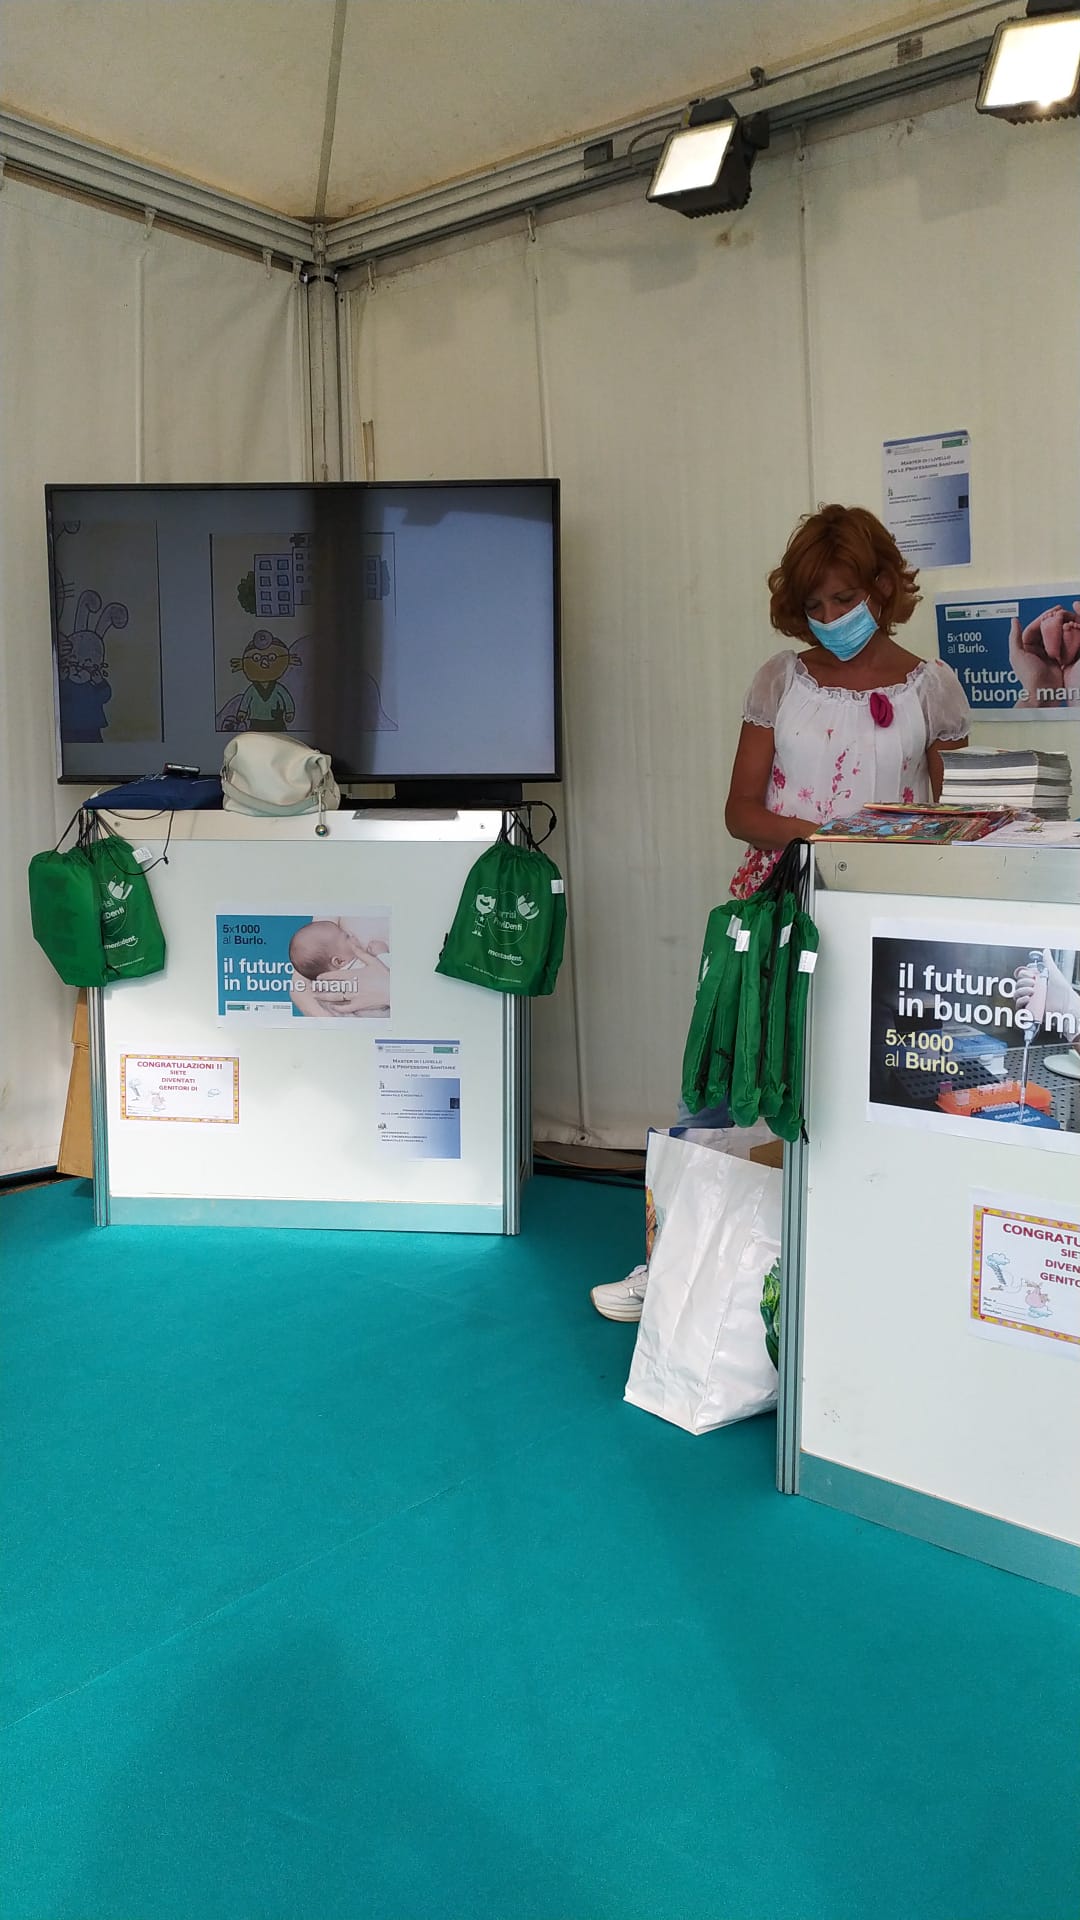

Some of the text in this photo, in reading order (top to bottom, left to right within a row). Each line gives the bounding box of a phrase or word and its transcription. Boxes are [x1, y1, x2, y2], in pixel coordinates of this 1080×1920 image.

[947, 631, 982, 642] 5x1000
[947, 643, 988, 654] al Burlo.
[963, 667, 1018, 684] futuro
[971, 685, 1029, 702] buone
[222, 924, 260, 934] 5x1000
[222, 935, 267, 945] al Burlo.
[223, 958, 295, 974] il futuro
[224, 976, 359, 993] in buone mani
[898, 962, 1017, 999] il futuro
[898, 991, 1080, 1034] in buone m
[885, 1028, 954, 1052] 5x1000
[137, 1061, 214, 1070] CONGRATULAZIONI
[884, 1050, 965, 1076] al Burlo.
